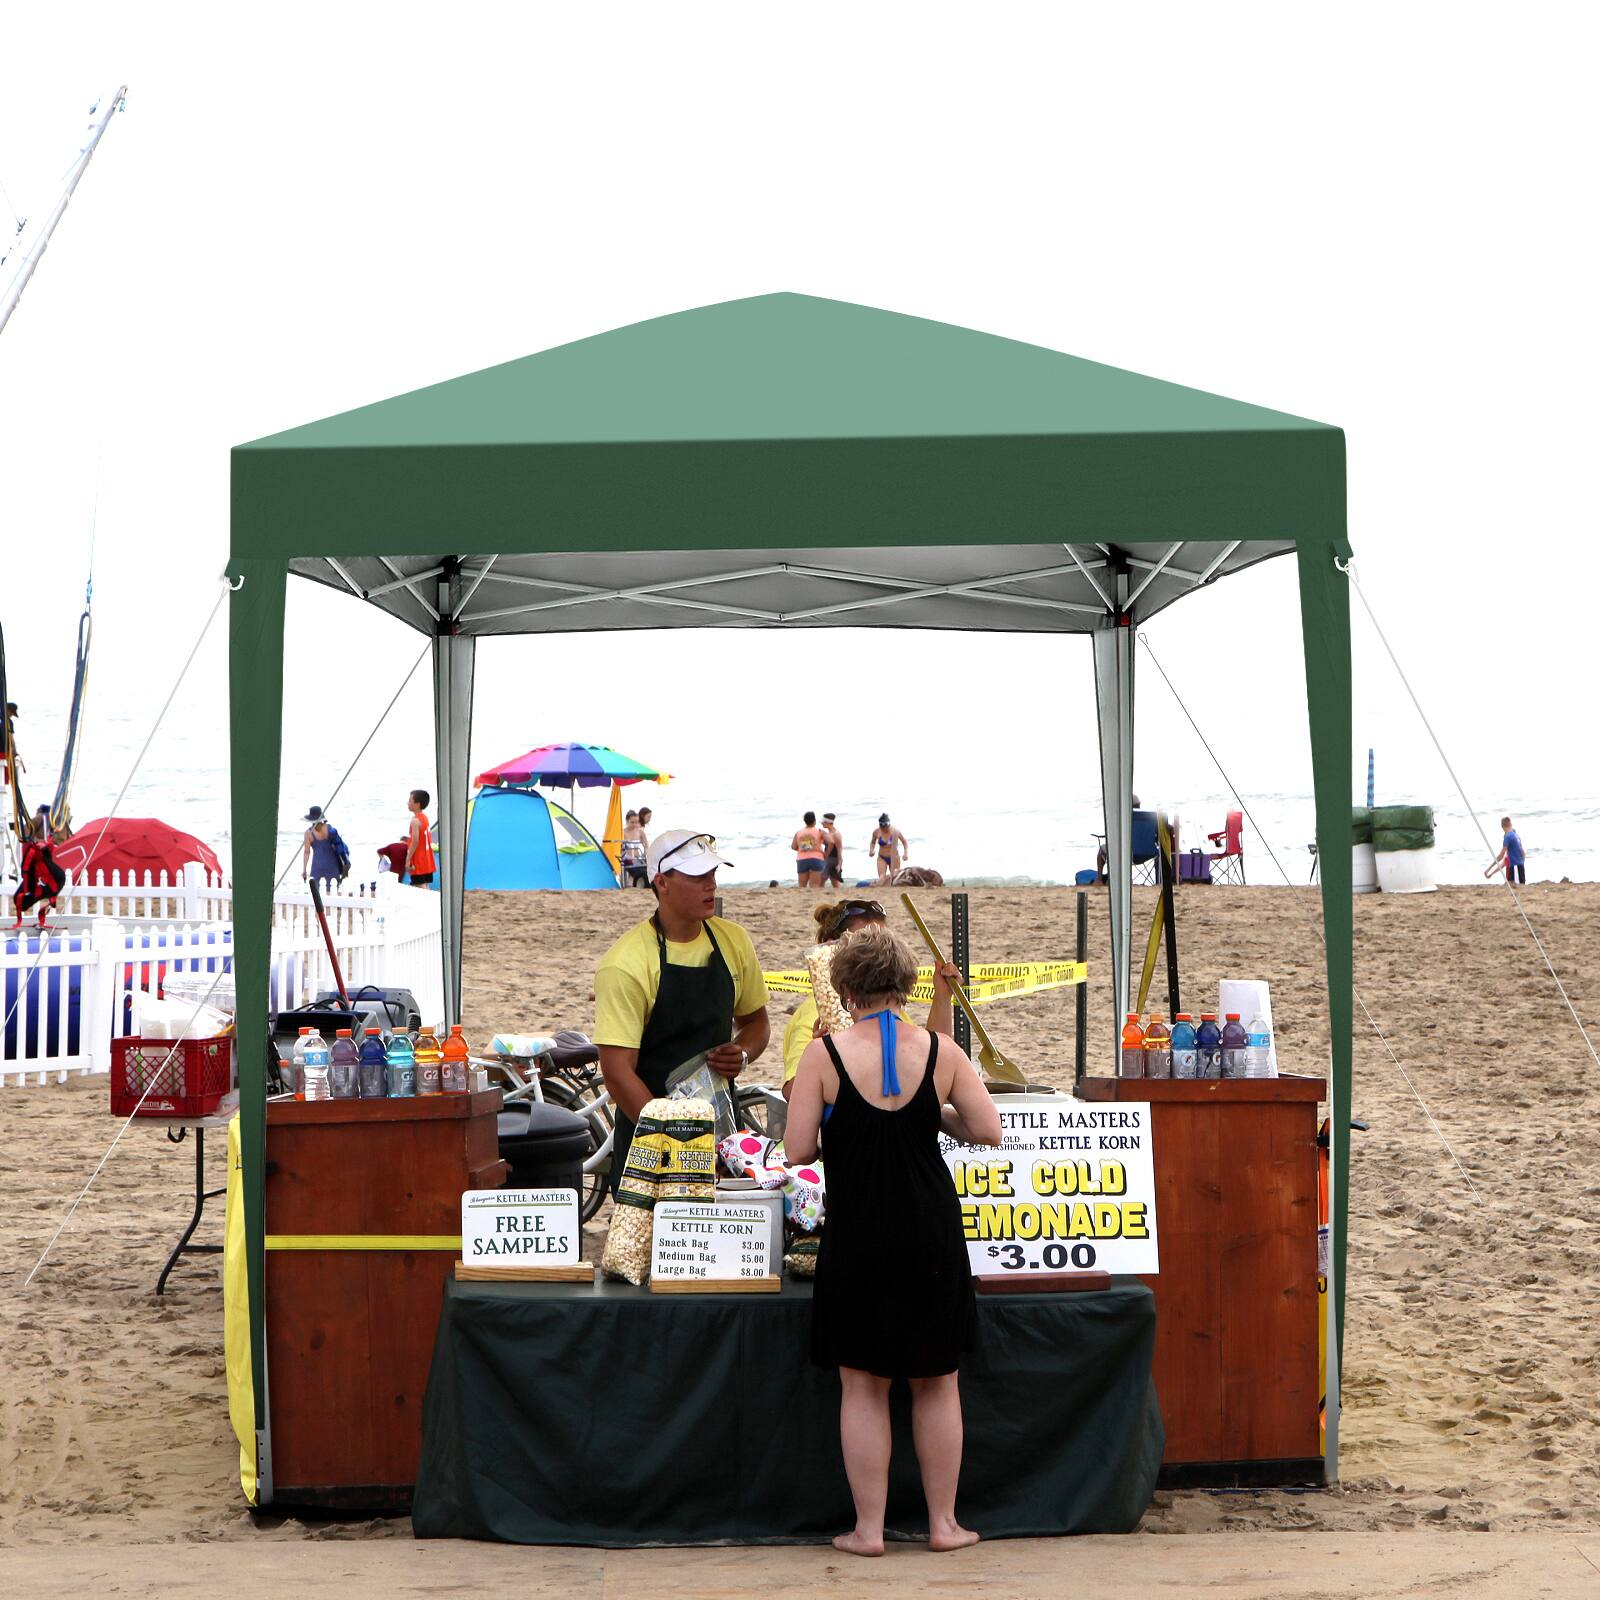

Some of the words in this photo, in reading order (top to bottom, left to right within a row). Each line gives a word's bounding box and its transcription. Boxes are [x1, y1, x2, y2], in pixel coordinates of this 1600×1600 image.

[423, 1070, 439, 1080] G2
[1000, 1112, 1049, 1129] ETTLE
[1058, 1111, 1141, 1129] MASTERS
[1039, 1136, 1092, 1150] KETTLE
[1099, 1135, 1141, 1150] KORN
[682, 1160, 711, 1170] KORN
[954, 1159, 1015, 1197] ICE
[1031, 1158, 1127, 1197] COLD
[496, 1194, 527, 1203] KETTLE
[531, 1193, 571, 1202] MASTERS
[689, 1207, 720, 1217] KETTLE
[724, 1208, 765, 1218] MASTERS
[495, 1215, 546, 1233] FREE
[961, 1202, 1150, 1241] EMONADE
[671, 1222, 714, 1234] KETTLE
[719, 1224, 753, 1235] KORN
[473, 1235, 569, 1256] SAMPLES
[658, 1238, 688, 1249] Snack
[691, 1239, 709, 1250] Bag
[741, 1241, 765, 1250] $3.00
[658, 1251, 695, 1261] Medium
[699, 1253, 717, 1264] Bag
[741, 1254, 764, 1264] $5.00
[987, 1243, 1097, 1270] $3.00
[658, 1265, 685, 1276] Large
[689, 1266, 706, 1277] Bag
[740, 1268, 764, 1277] $8.00
